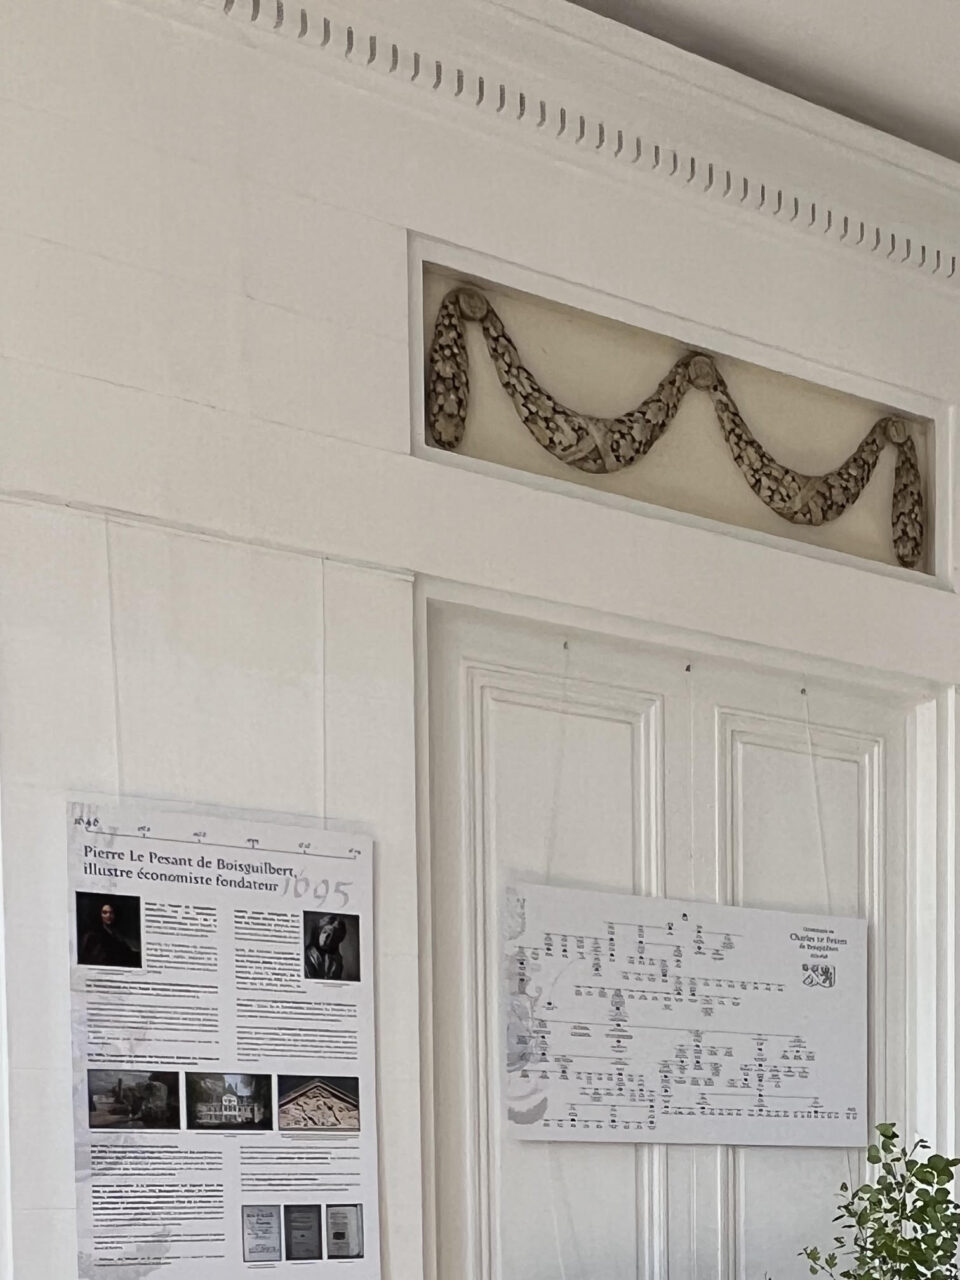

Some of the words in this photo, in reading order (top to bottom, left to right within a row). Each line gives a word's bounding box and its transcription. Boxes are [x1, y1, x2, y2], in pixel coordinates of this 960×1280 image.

[83, 845, 125, 860] Pierre
[130, 850, 144, 862] Le
[149, 851, 193, 867] Pesant
[197, 856, 212, 869] de
[83, 862, 133, 878] illustre
[137, 868, 212, 886] économiste
[216, 874, 279, 891] fondateur
[281, 870, 353, 908] 1695
